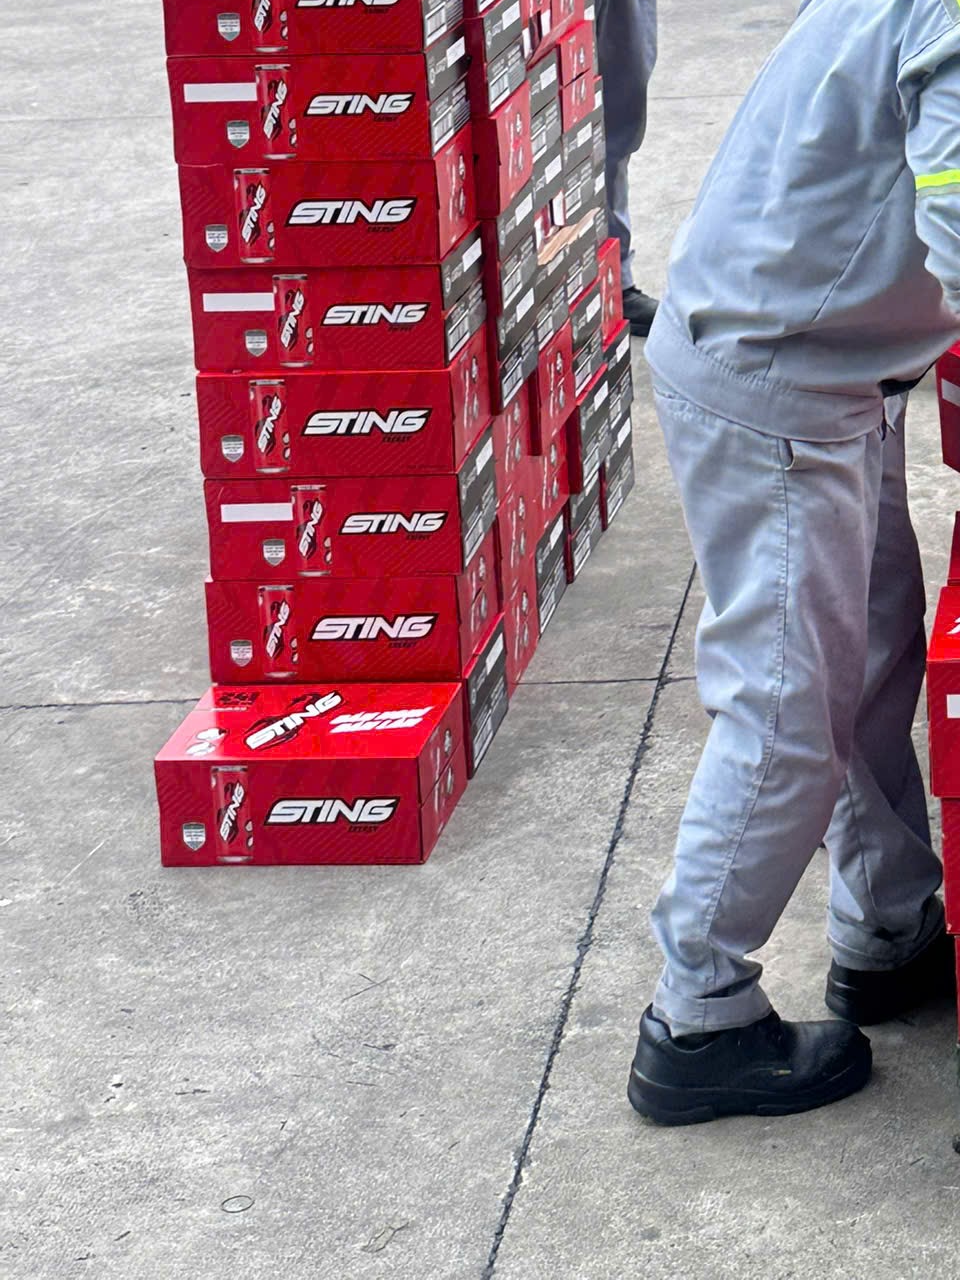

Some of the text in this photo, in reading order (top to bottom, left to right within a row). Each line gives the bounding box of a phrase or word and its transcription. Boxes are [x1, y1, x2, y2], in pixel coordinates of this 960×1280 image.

[263, 80, 288, 139] STING
[306, 93, 412, 115] STING
[241, 185, 266, 243] STING
[288, 199, 414, 225] STING
[280, 291, 305, 348] STING
[323, 303, 427, 325] STING
[257, 396, 282, 453] STING
[304, 409, 428, 435] STING
[298, 501, 323, 557] STING
[341, 512, 445, 534] STING
[265, 602, 290, 658] STING
[311, 615, 434, 640] STING
[245, 691, 342, 750] STING
[219, 782, 245, 842] STING
[268, 799, 396, 823] STING
